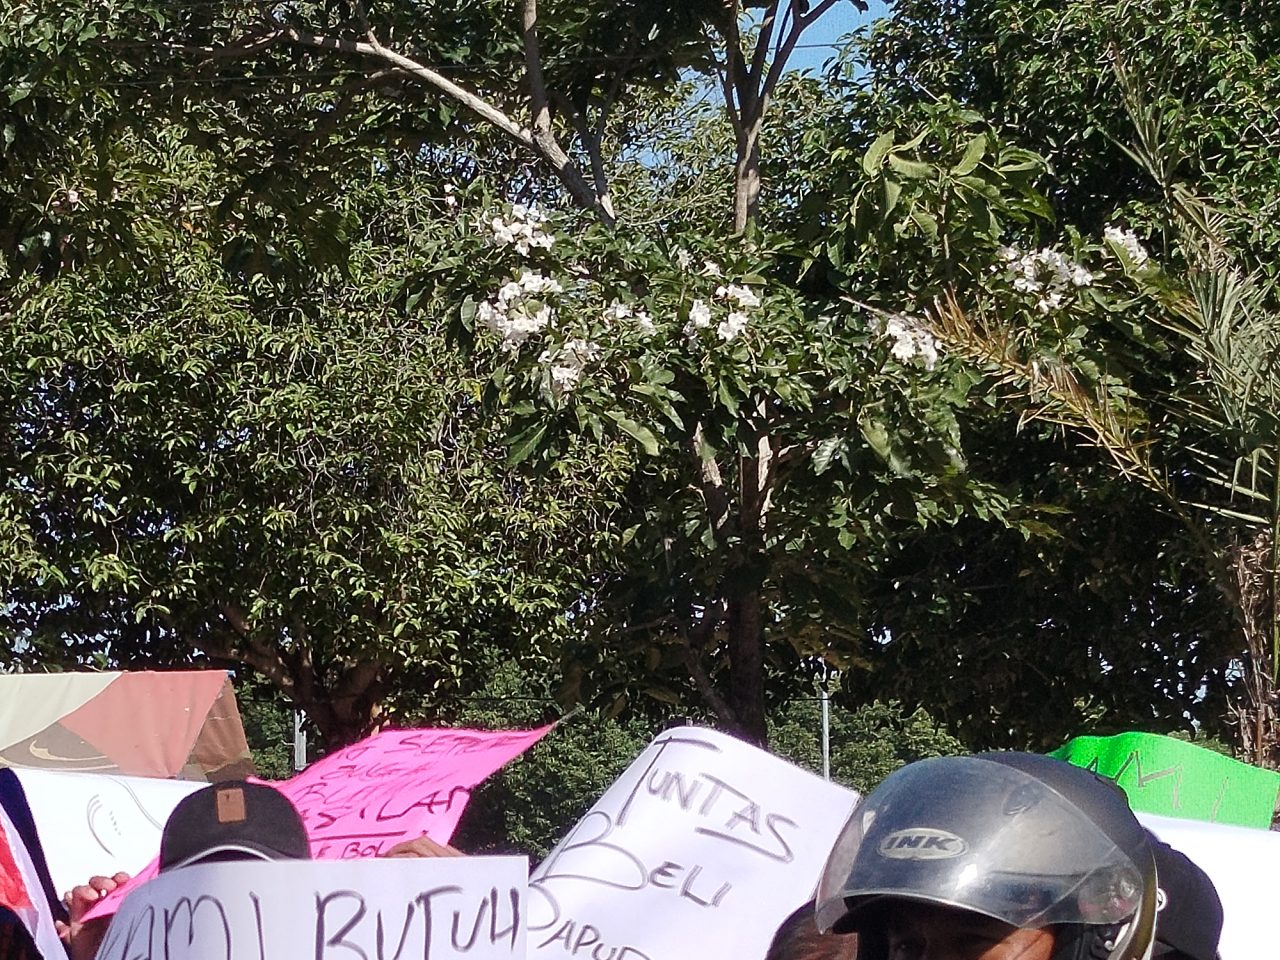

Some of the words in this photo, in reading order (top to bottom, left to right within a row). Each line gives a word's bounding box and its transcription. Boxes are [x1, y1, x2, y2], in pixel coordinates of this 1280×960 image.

[616, 736, 799, 863] TUNTAS
[884, 835, 960, 851] INK
[528, 811, 732, 907] BELI
